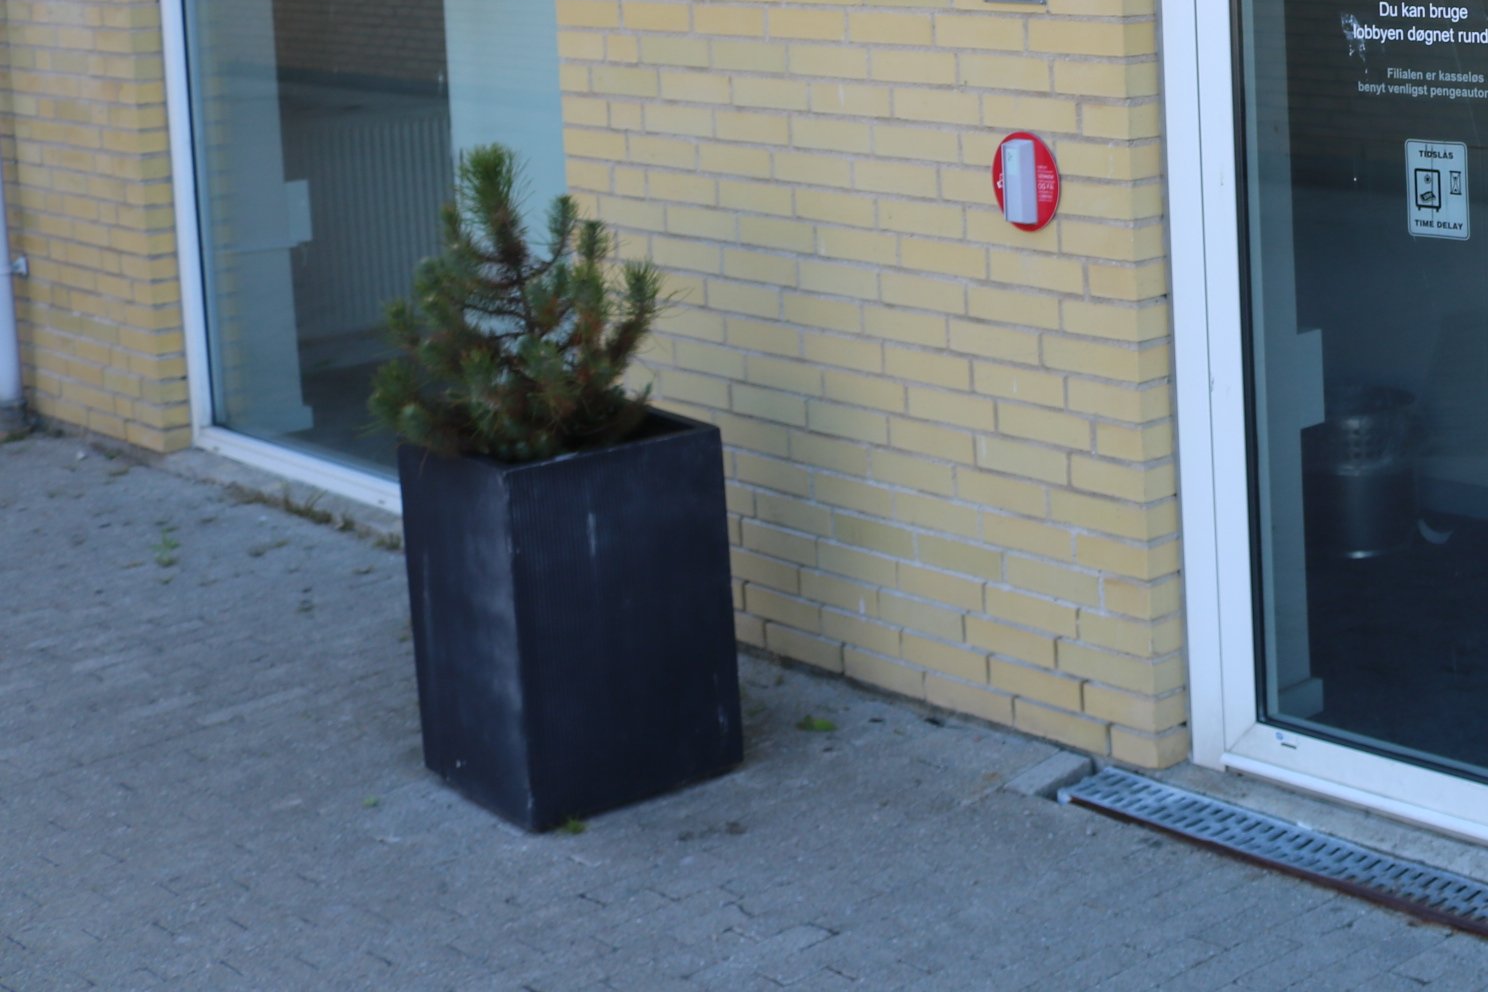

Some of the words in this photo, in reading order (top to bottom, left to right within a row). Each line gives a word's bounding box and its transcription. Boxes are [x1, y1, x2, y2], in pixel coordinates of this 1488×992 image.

[1379, 2, 1398, 18] Du
[1402, 2, 1426, 18] kan
[1429, 4, 1468, 22] bruge
[1353, 26, 1404, 44] lobbyen
[1407, 27, 1454, 46] døgnet
[1387, 68, 1424, 80] Filialen
[1426, 72, 1436, 82] er
[1438, 70, 1484, 84] kasseløs
[1358, 81, 1386, 96] benyt
[1388, 82, 1428, 98] venligst
[1419, 150, 1454, 160] TIDSLÅS
[1415, 219, 1434, 228] TIME
[1437, 222, 1464, 230] DELAY
